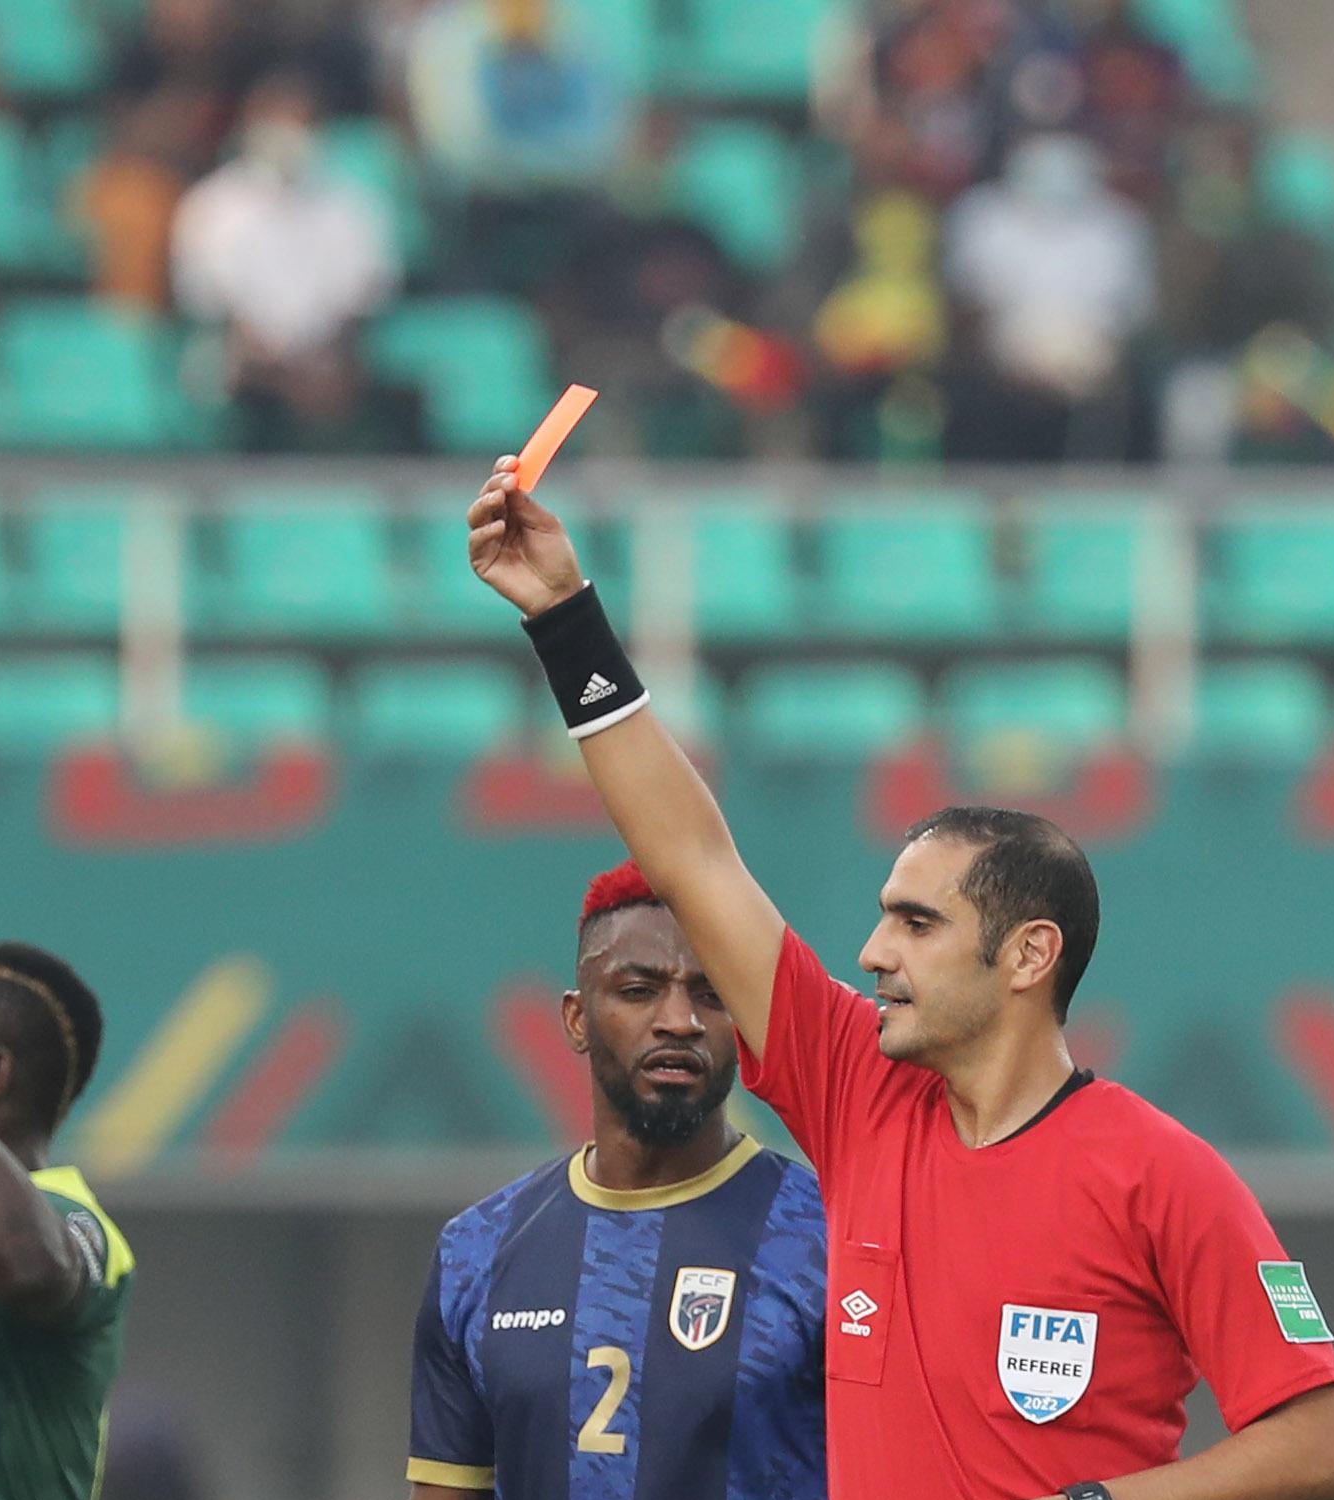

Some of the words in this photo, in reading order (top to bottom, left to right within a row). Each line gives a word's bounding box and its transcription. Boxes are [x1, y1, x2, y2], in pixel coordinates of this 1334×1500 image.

[579, 682, 618, 706] adidas
[683, 1273, 730, 1286] FCF
[492, 1308, 566, 1331] tempo
[1010, 1312, 1085, 1345] FIFA
[1007, 1357, 1082, 1378] REFEREE
[578, 1345, 632, 1454] 2
